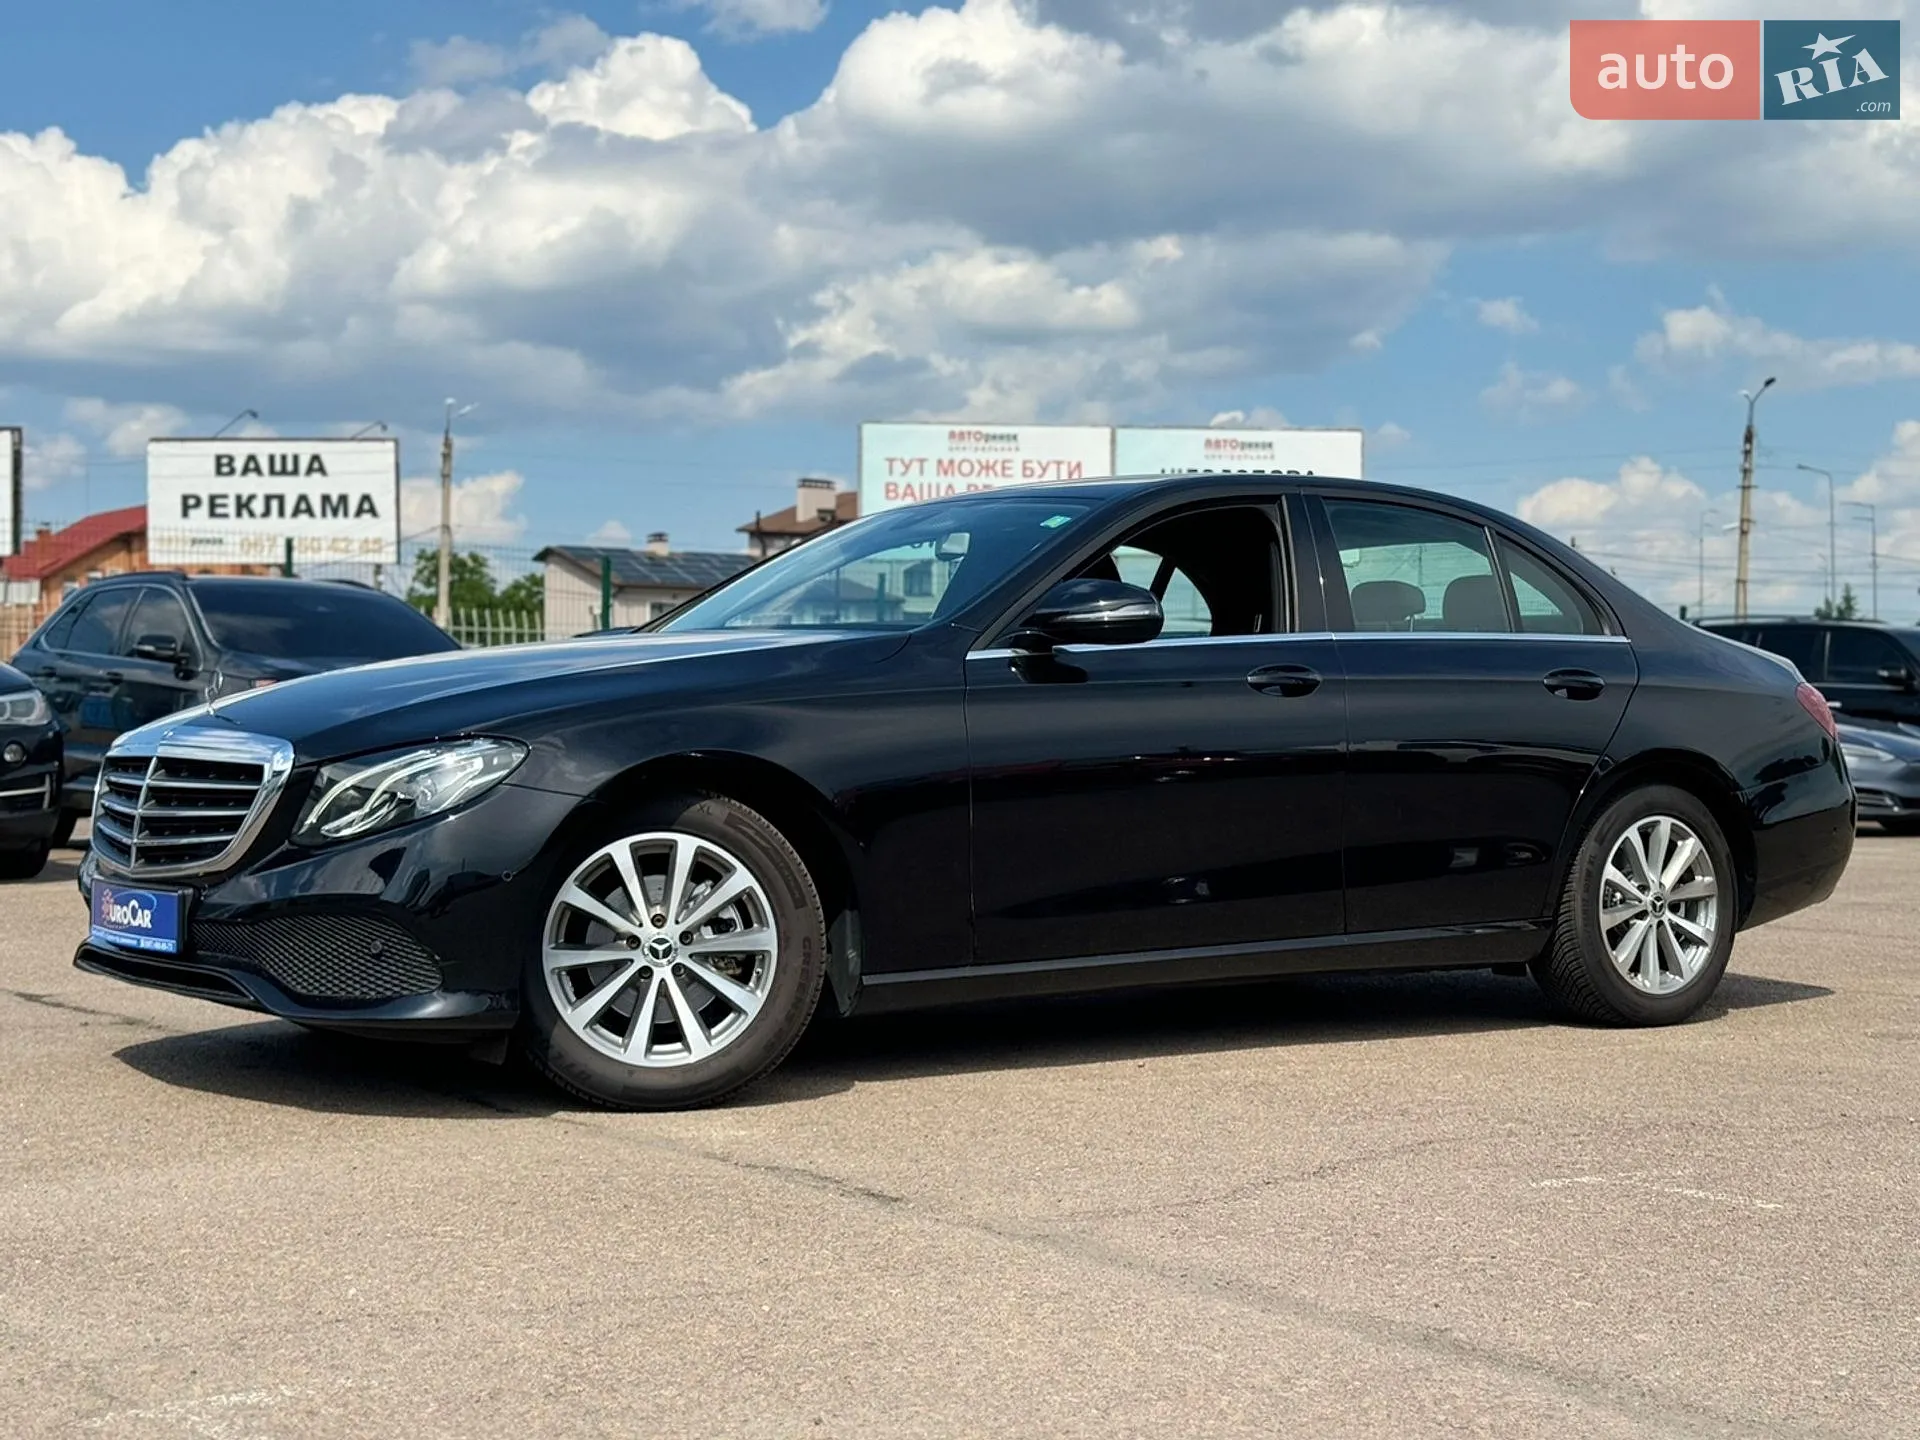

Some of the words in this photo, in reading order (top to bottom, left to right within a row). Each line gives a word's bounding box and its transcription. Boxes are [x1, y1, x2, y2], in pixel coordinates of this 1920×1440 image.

[214, 453, 328, 477] ВАША
[884, 457, 928, 477] ТУТ
[936, 458, 1014, 479] МОЖЕ
[1021, 459, 1083, 480] БУТИ
[181, 493, 380, 519] РЕКЛАМА
